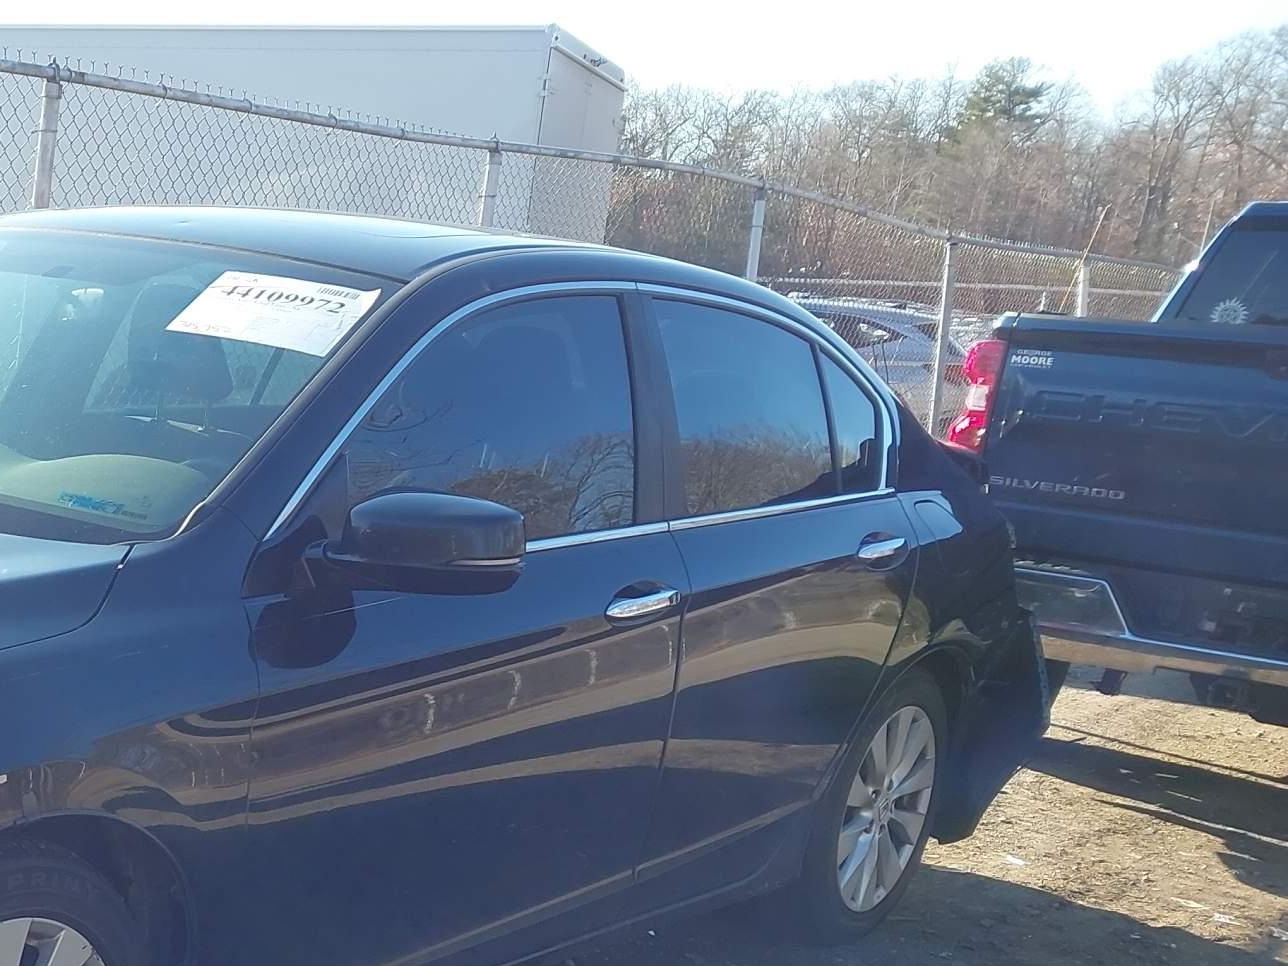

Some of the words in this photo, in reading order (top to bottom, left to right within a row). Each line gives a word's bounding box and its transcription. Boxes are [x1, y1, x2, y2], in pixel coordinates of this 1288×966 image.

[220, 285, 347, 314] 44109972
[1011, 354, 1055, 366] MOORE
[1032, 389, 1288, 440] CHEV
[989, 475, 1127, 501] SILVERADO
